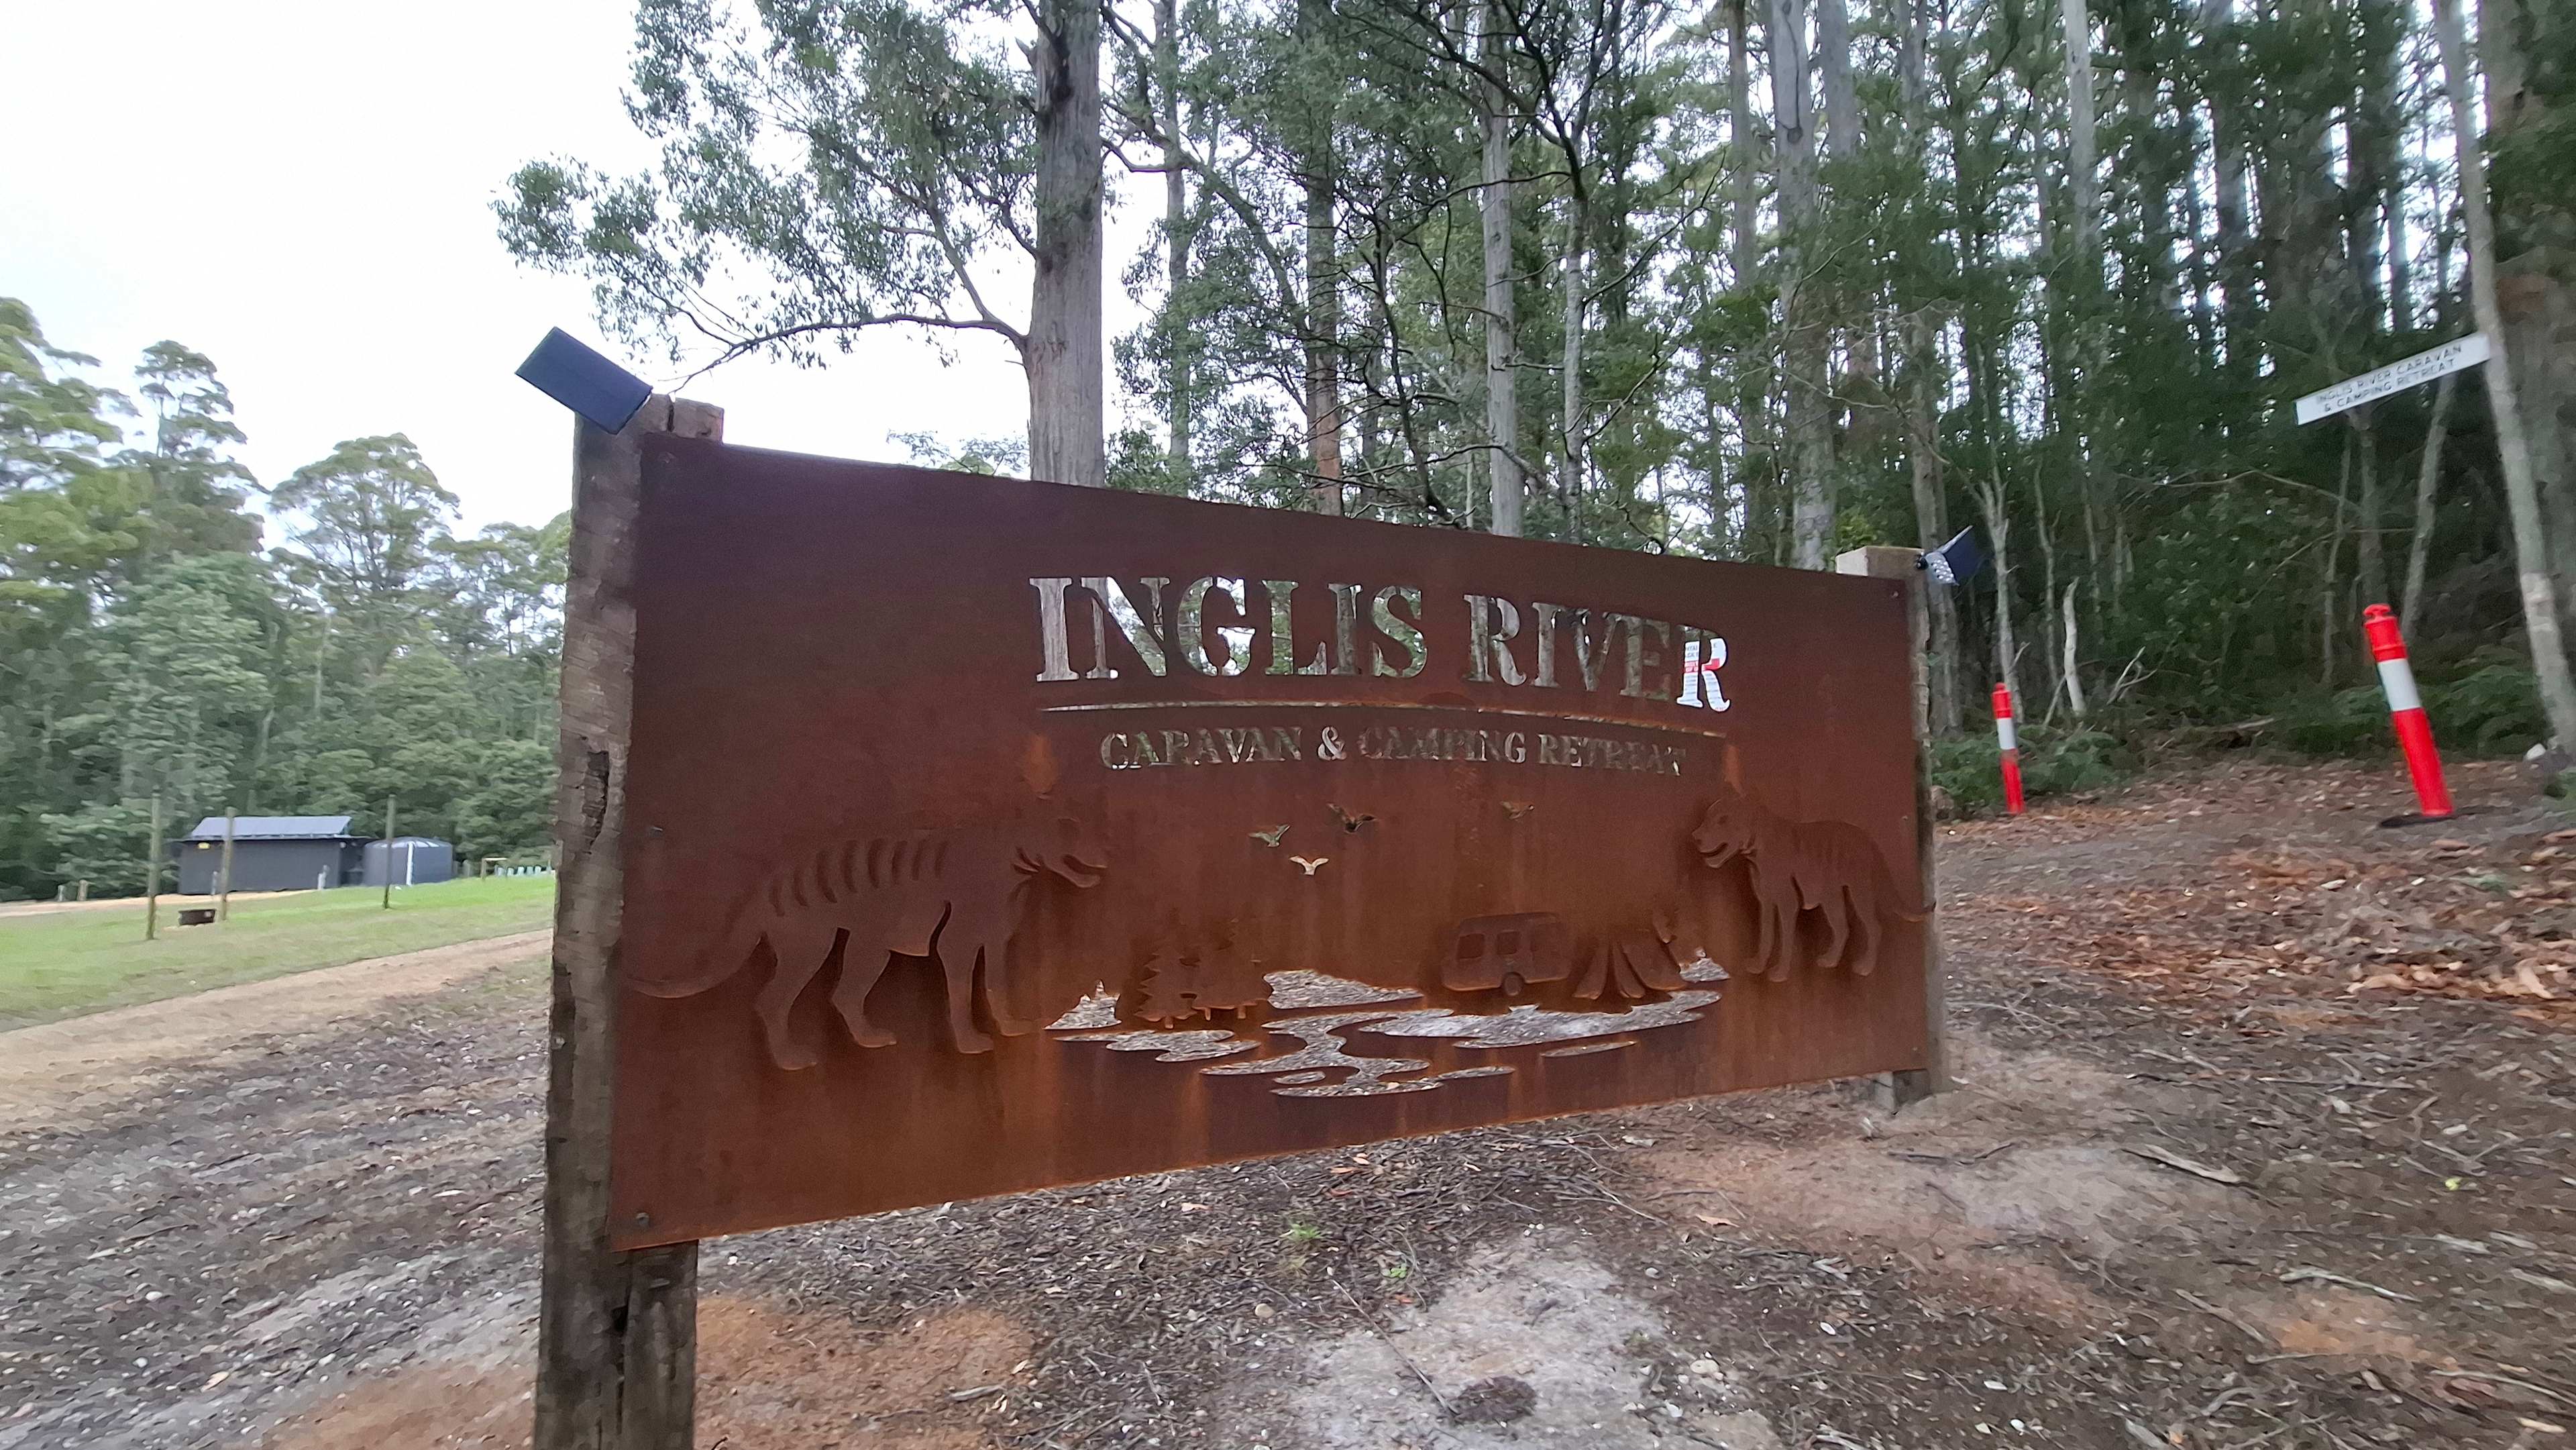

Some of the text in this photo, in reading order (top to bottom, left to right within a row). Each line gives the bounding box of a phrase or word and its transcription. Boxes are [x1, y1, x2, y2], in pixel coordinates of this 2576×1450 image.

[2396, 344, 2461, 374] CARAVAN
[2337, 381, 2392, 407] CAMPING
[1028, 576, 1731, 712] INGLIS RIVER
[1099, 725, 1688, 777] CARAVAN & CAMPING RETREAT
